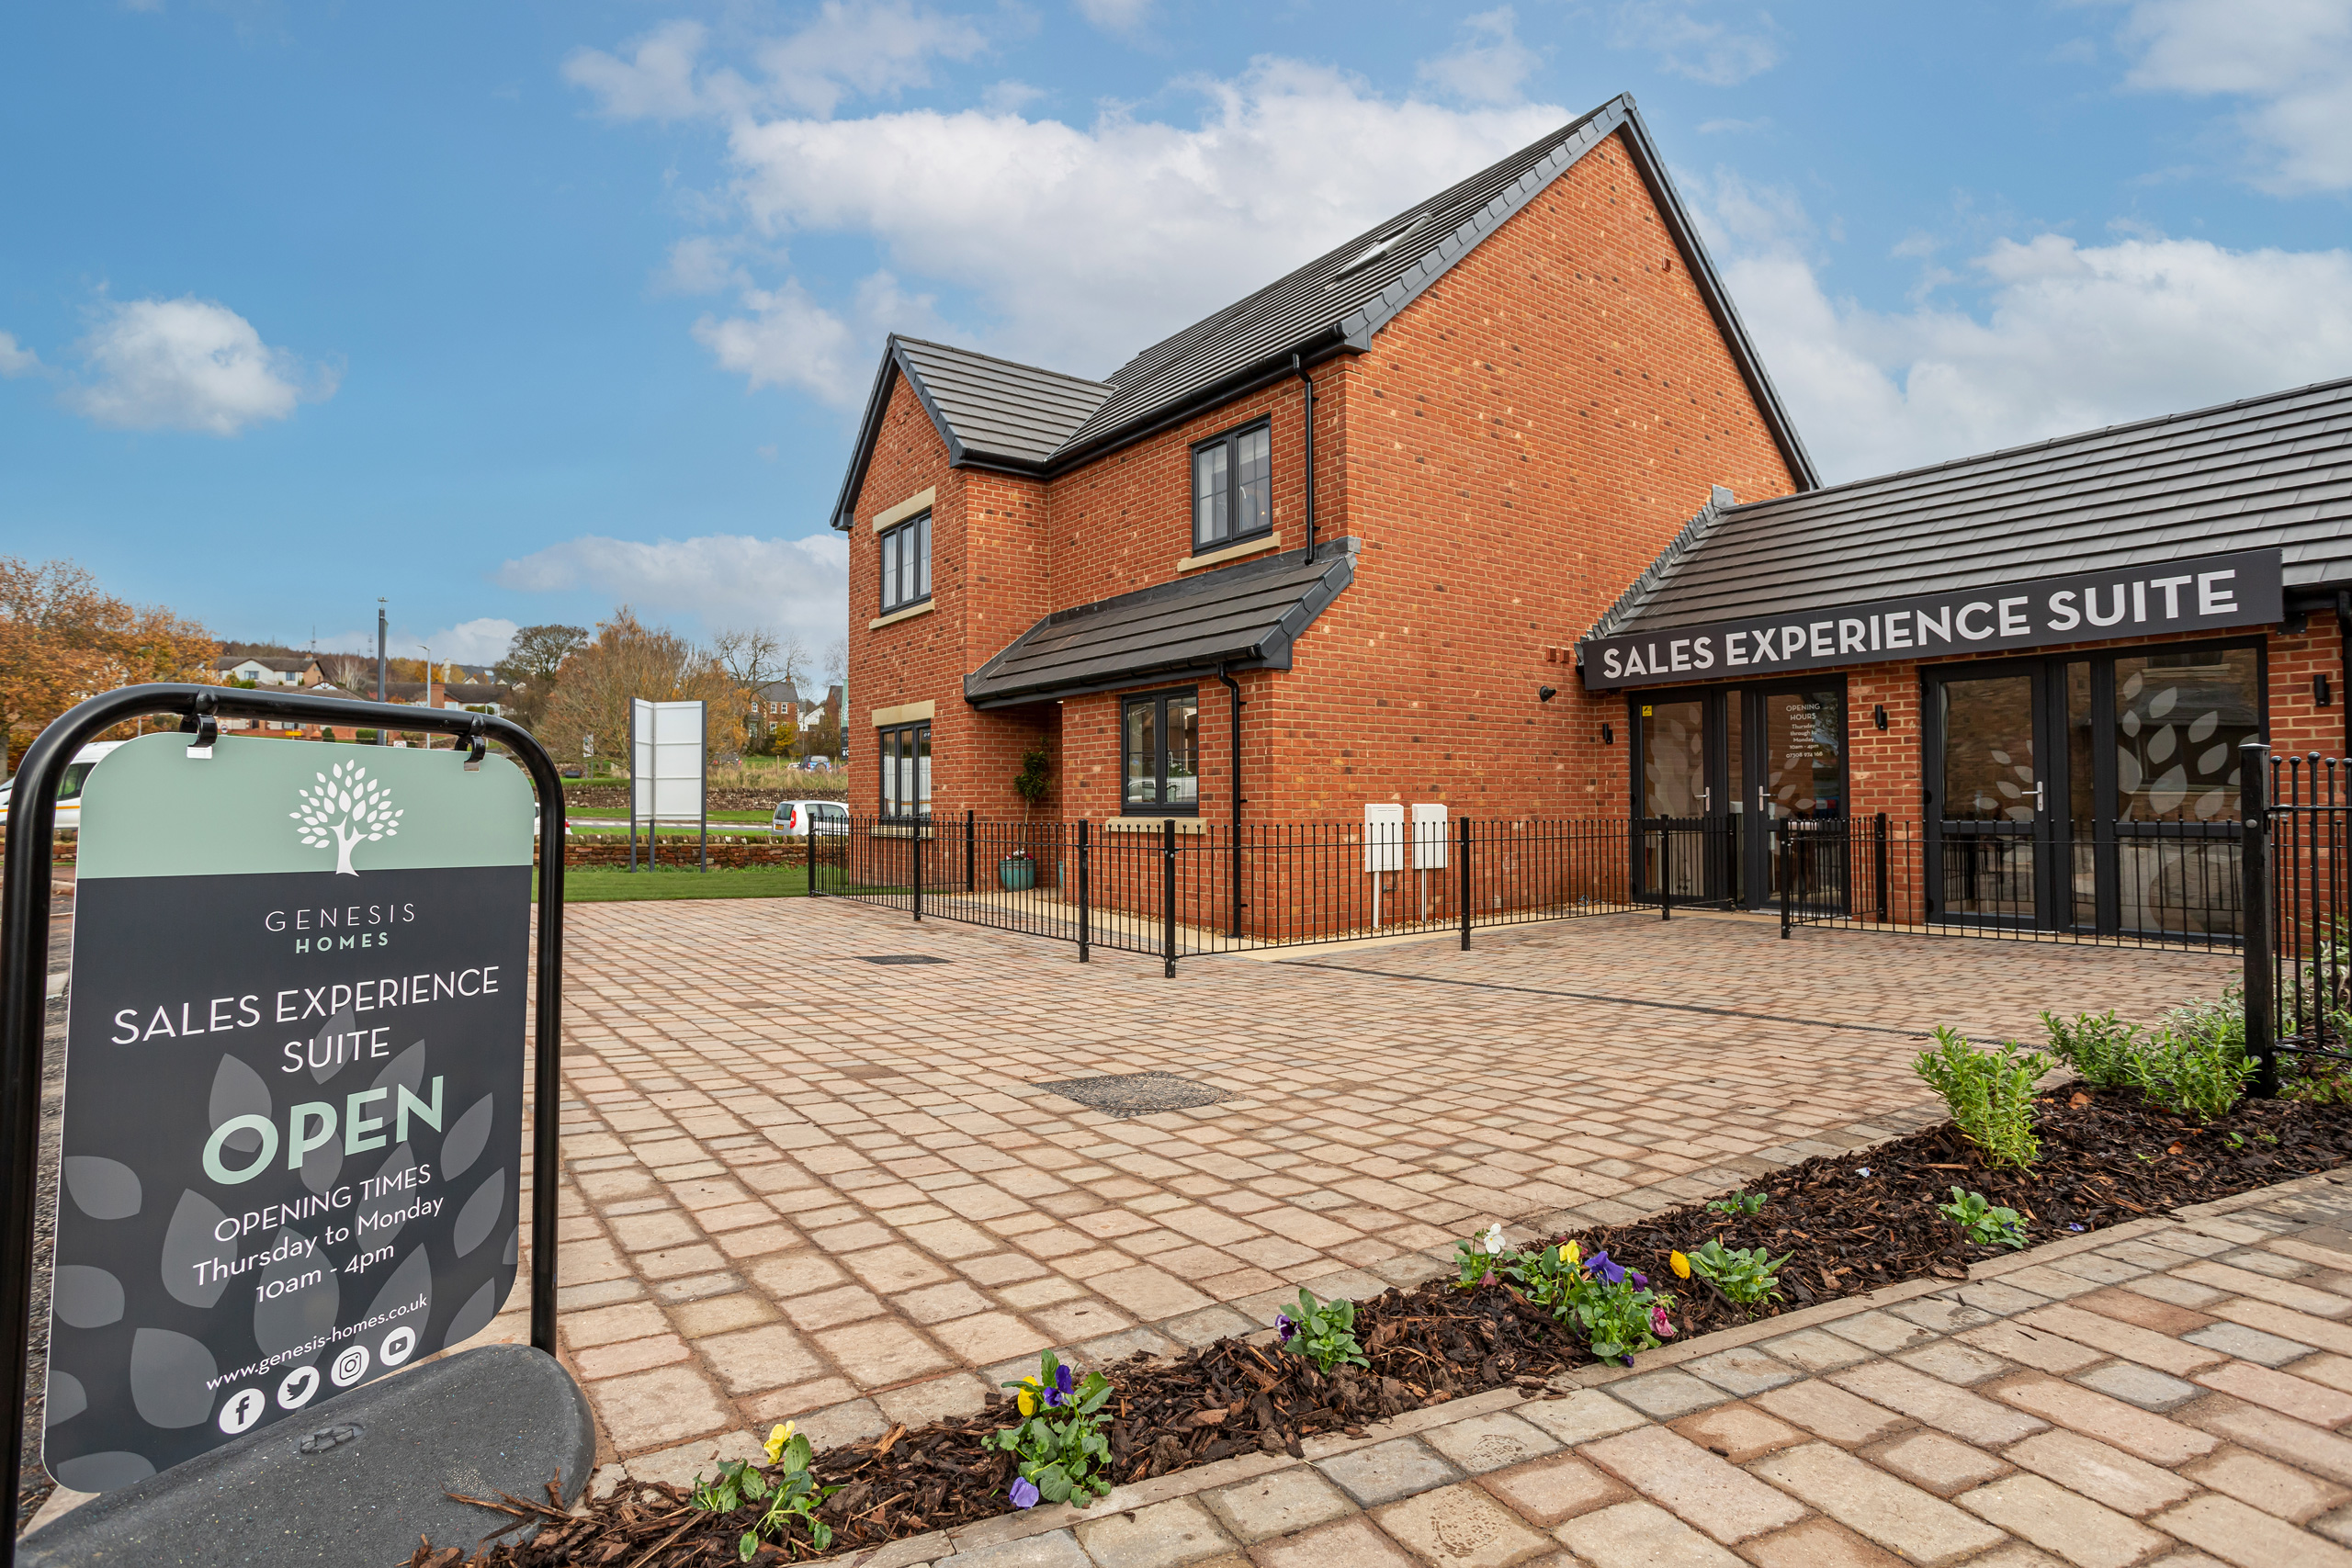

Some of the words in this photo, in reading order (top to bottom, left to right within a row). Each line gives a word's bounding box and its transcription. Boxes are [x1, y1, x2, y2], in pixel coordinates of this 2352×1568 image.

[1603, 637, 1714, 679] SALES
[1725, 596, 2030, 666] EXPERIENCE
[2047, 570, 2238, 631] SUITE
[1786, 704, 1820, 712] OPENING
[265, 903, 415, 932] GENESIS
[295, 931, 389, 954] HOMES
[110, 995, 261, 1044] SALES
[277, 965, 500, 1023] EXPERIENCE
[281, 1026, 390, 1073] SUITE
[202, 1075, 444, 1185] OPEN
[192, 1235, 318, 1286] Thursday
[325, 1225, 350, 1246] to
[357, 1196, 445, 1236] Monday
[214, 1186, 352, 1242] OPENING
[359, 1164, 432, 1201] TIMES
[255, 1269, 322, 1303] 10am
[344, 1245, 394, 1274] 4pm
[206, 1293, 428, 1391] www.genesis-homes.co.uk
